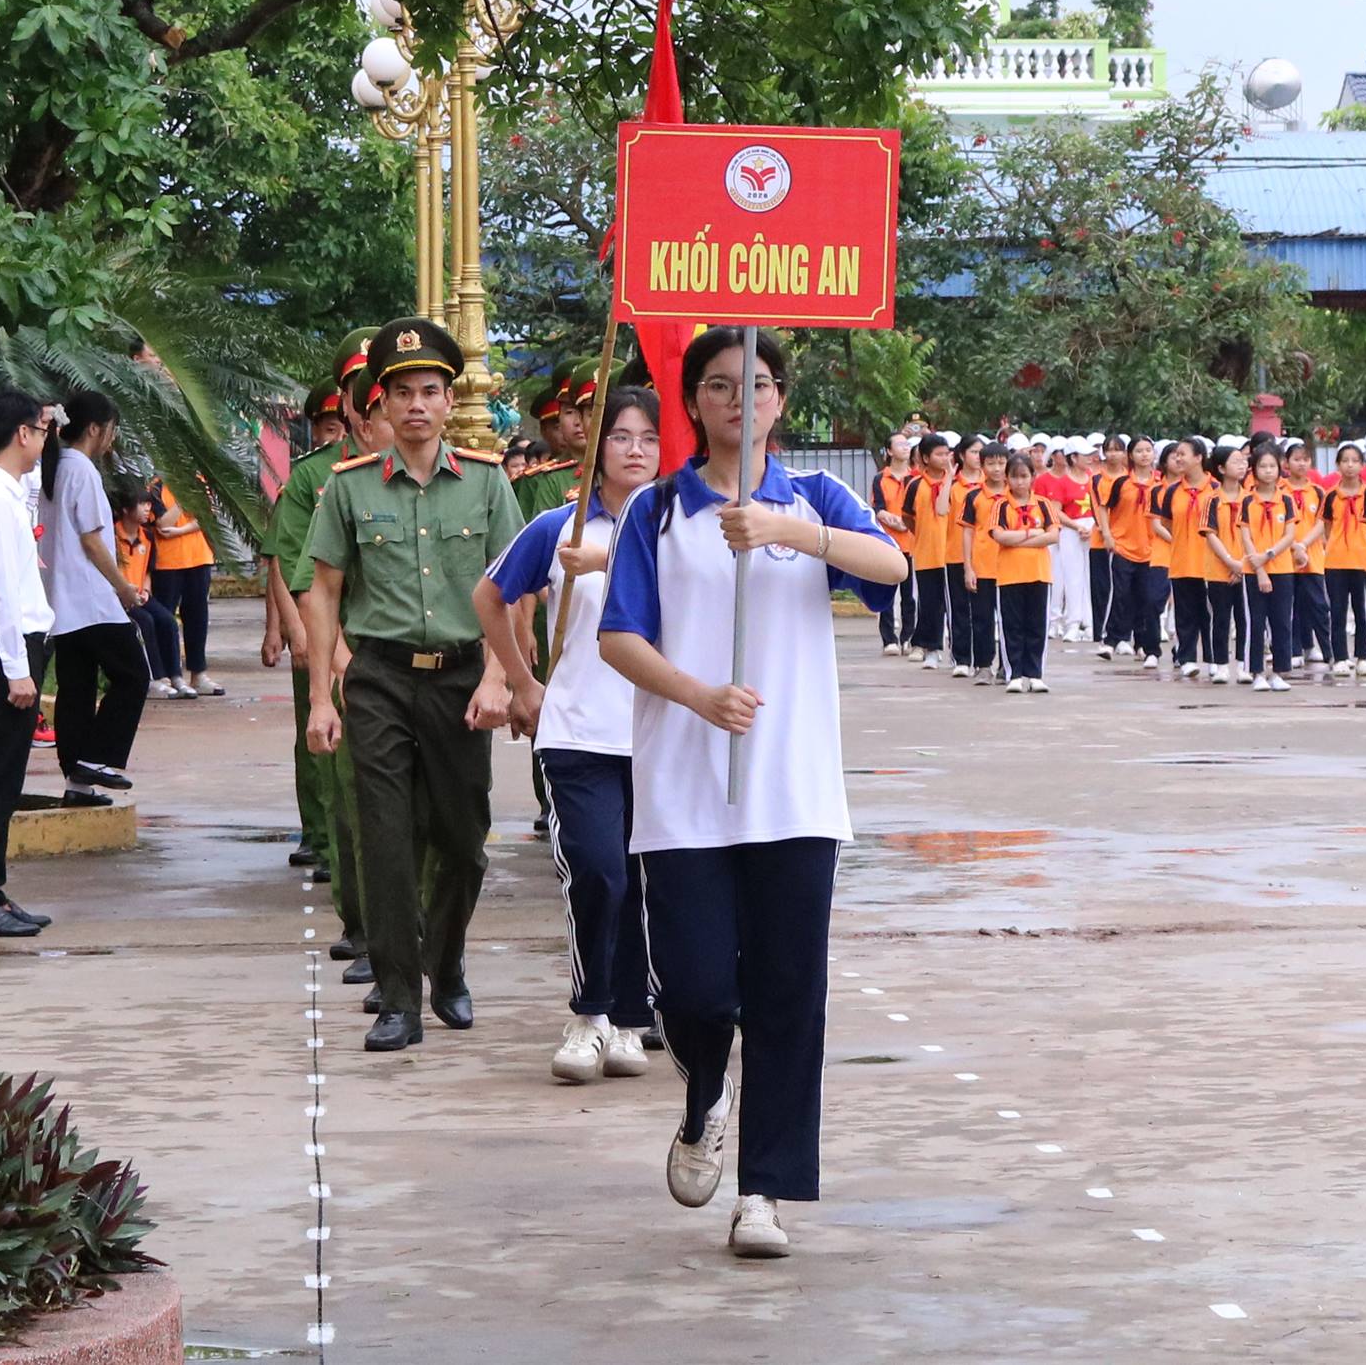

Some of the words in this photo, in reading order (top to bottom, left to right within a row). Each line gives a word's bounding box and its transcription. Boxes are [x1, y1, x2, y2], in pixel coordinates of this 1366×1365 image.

[650, 223, 718, 293] KHỐI
[728, 232, 809, 295] CÔNG
[817, 245, 860, 296] AN
